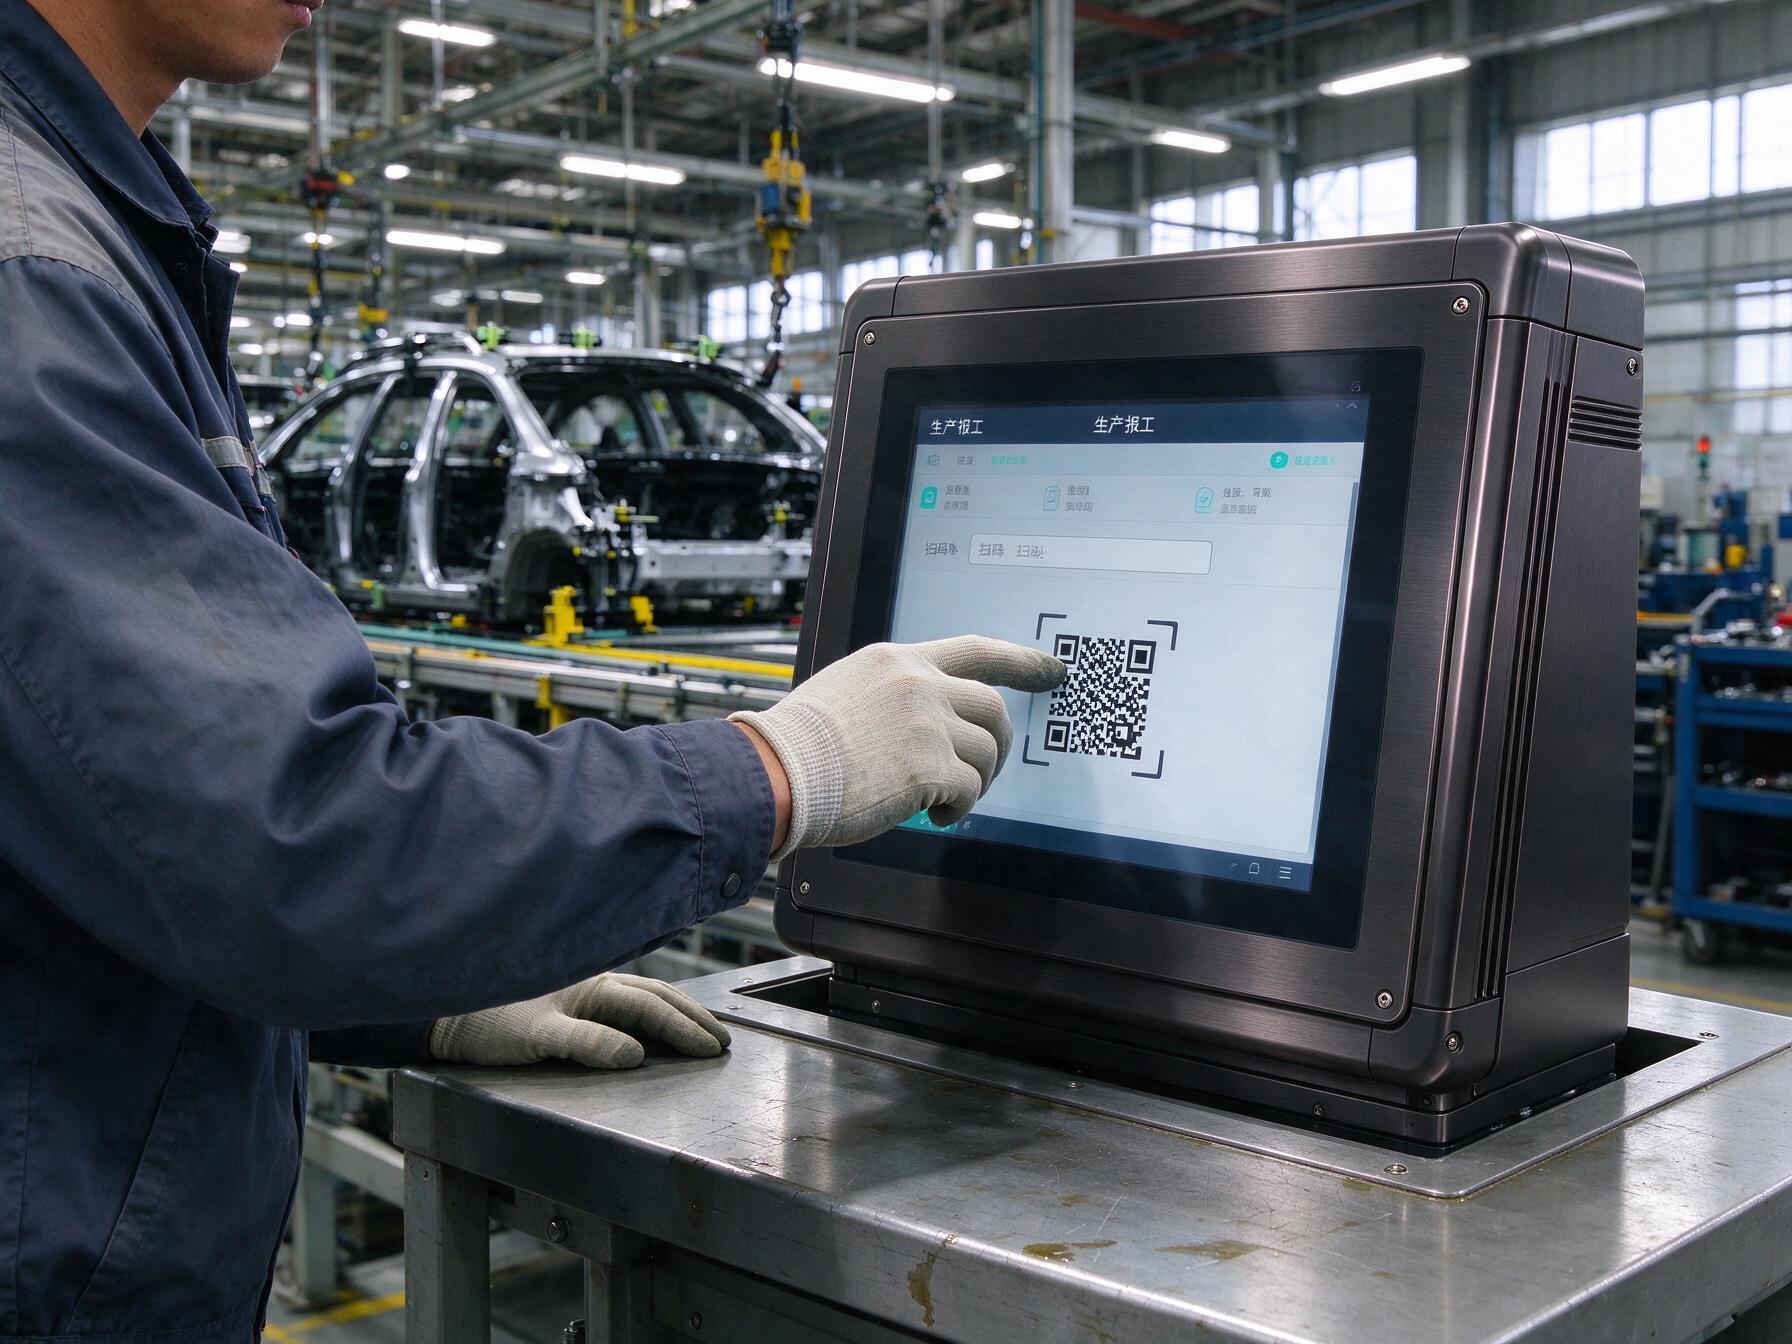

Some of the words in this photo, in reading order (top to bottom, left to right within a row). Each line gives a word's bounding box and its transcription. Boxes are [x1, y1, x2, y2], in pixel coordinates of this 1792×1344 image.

[929, 419, 984, 435] 生产报工
[1093, 415, 1155, 433] 生产报工
